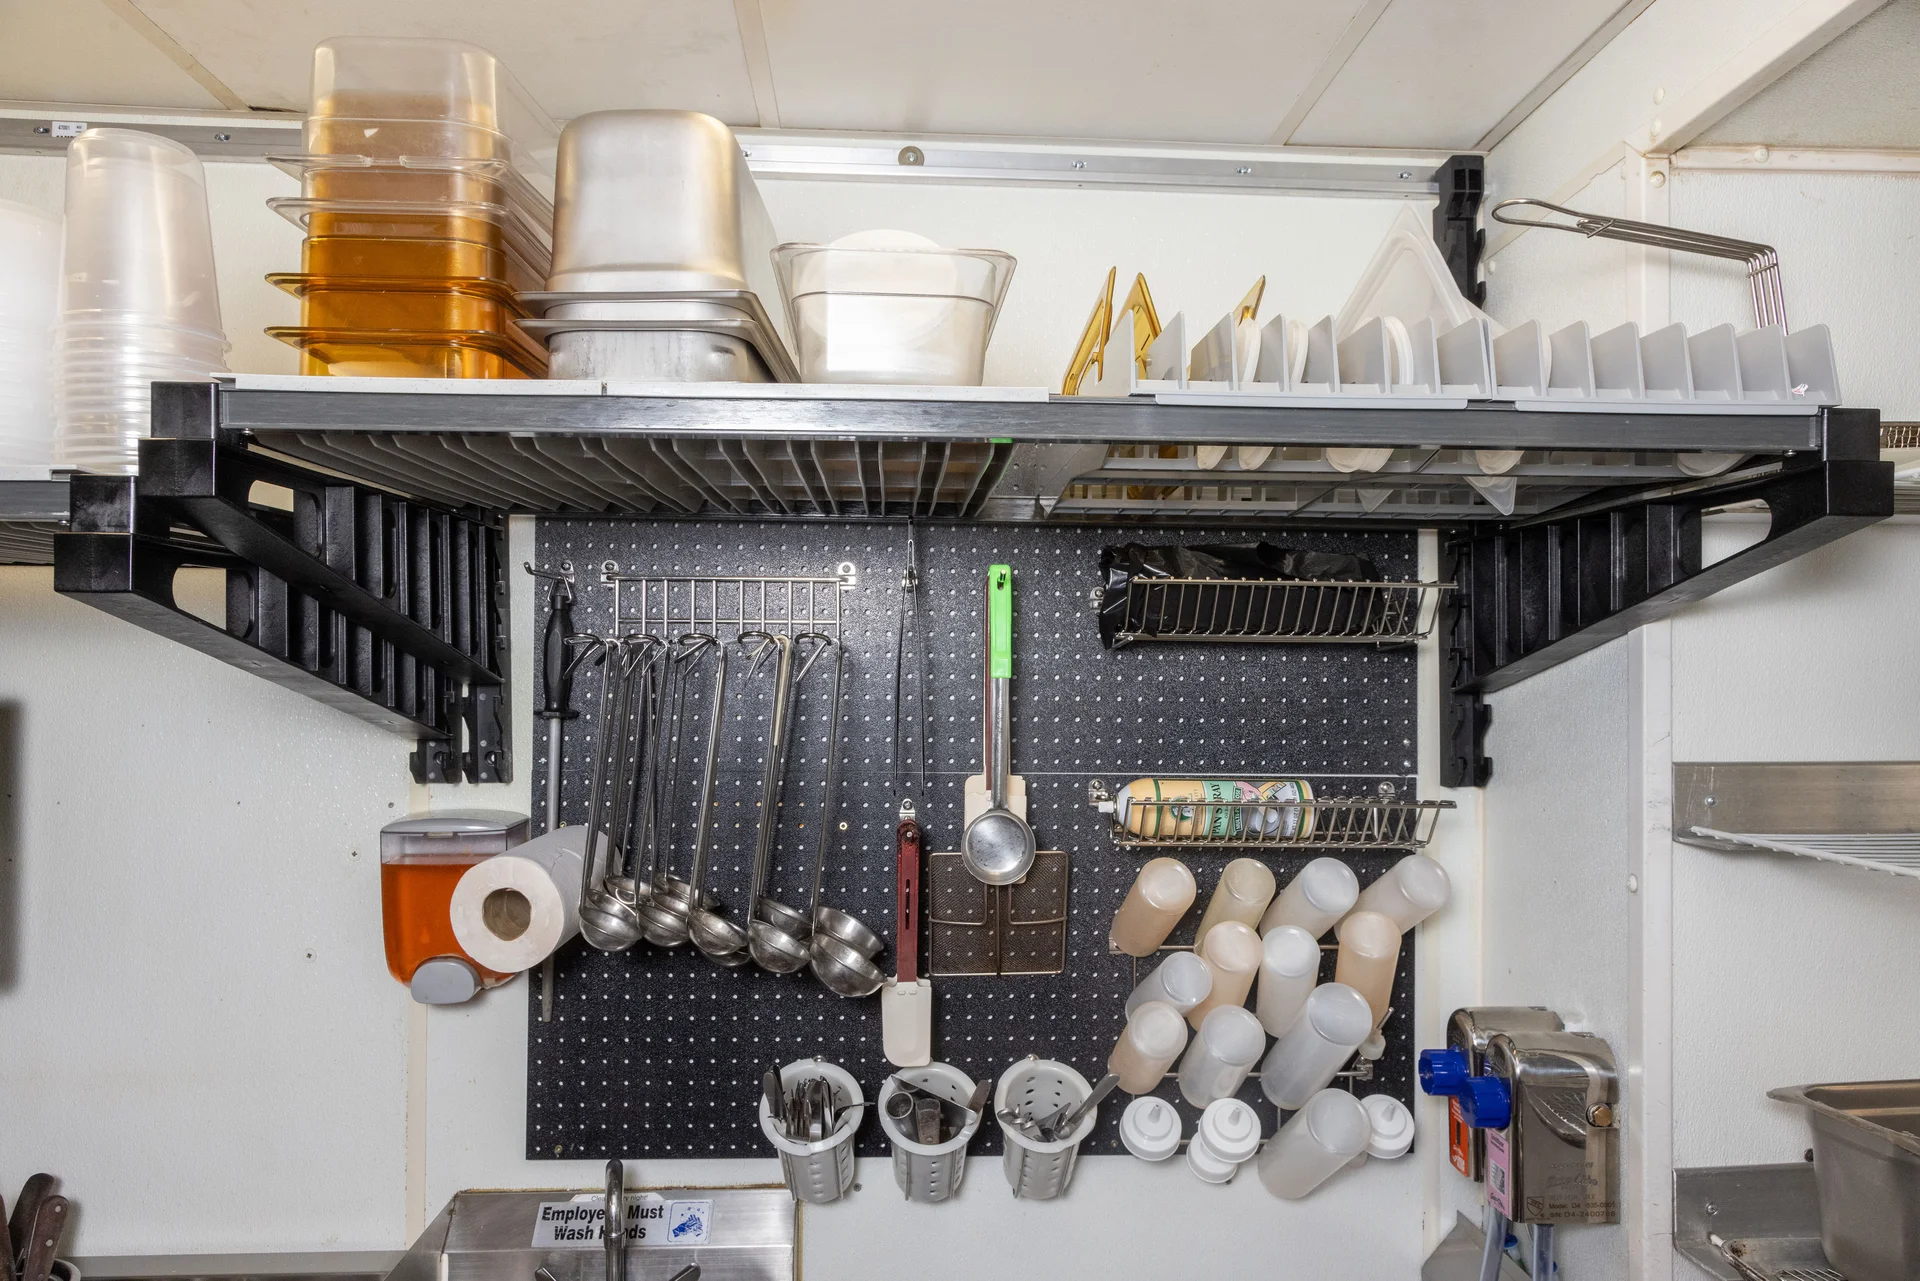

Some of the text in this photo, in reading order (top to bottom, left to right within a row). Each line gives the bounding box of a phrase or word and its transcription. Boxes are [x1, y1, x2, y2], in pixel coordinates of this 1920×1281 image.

[1210, 783, 1223, 835] PAN SRAY
[542, 1205, 664, 1224] Employe Must
[554, 1224, 647, 1241] Wash Hnds
